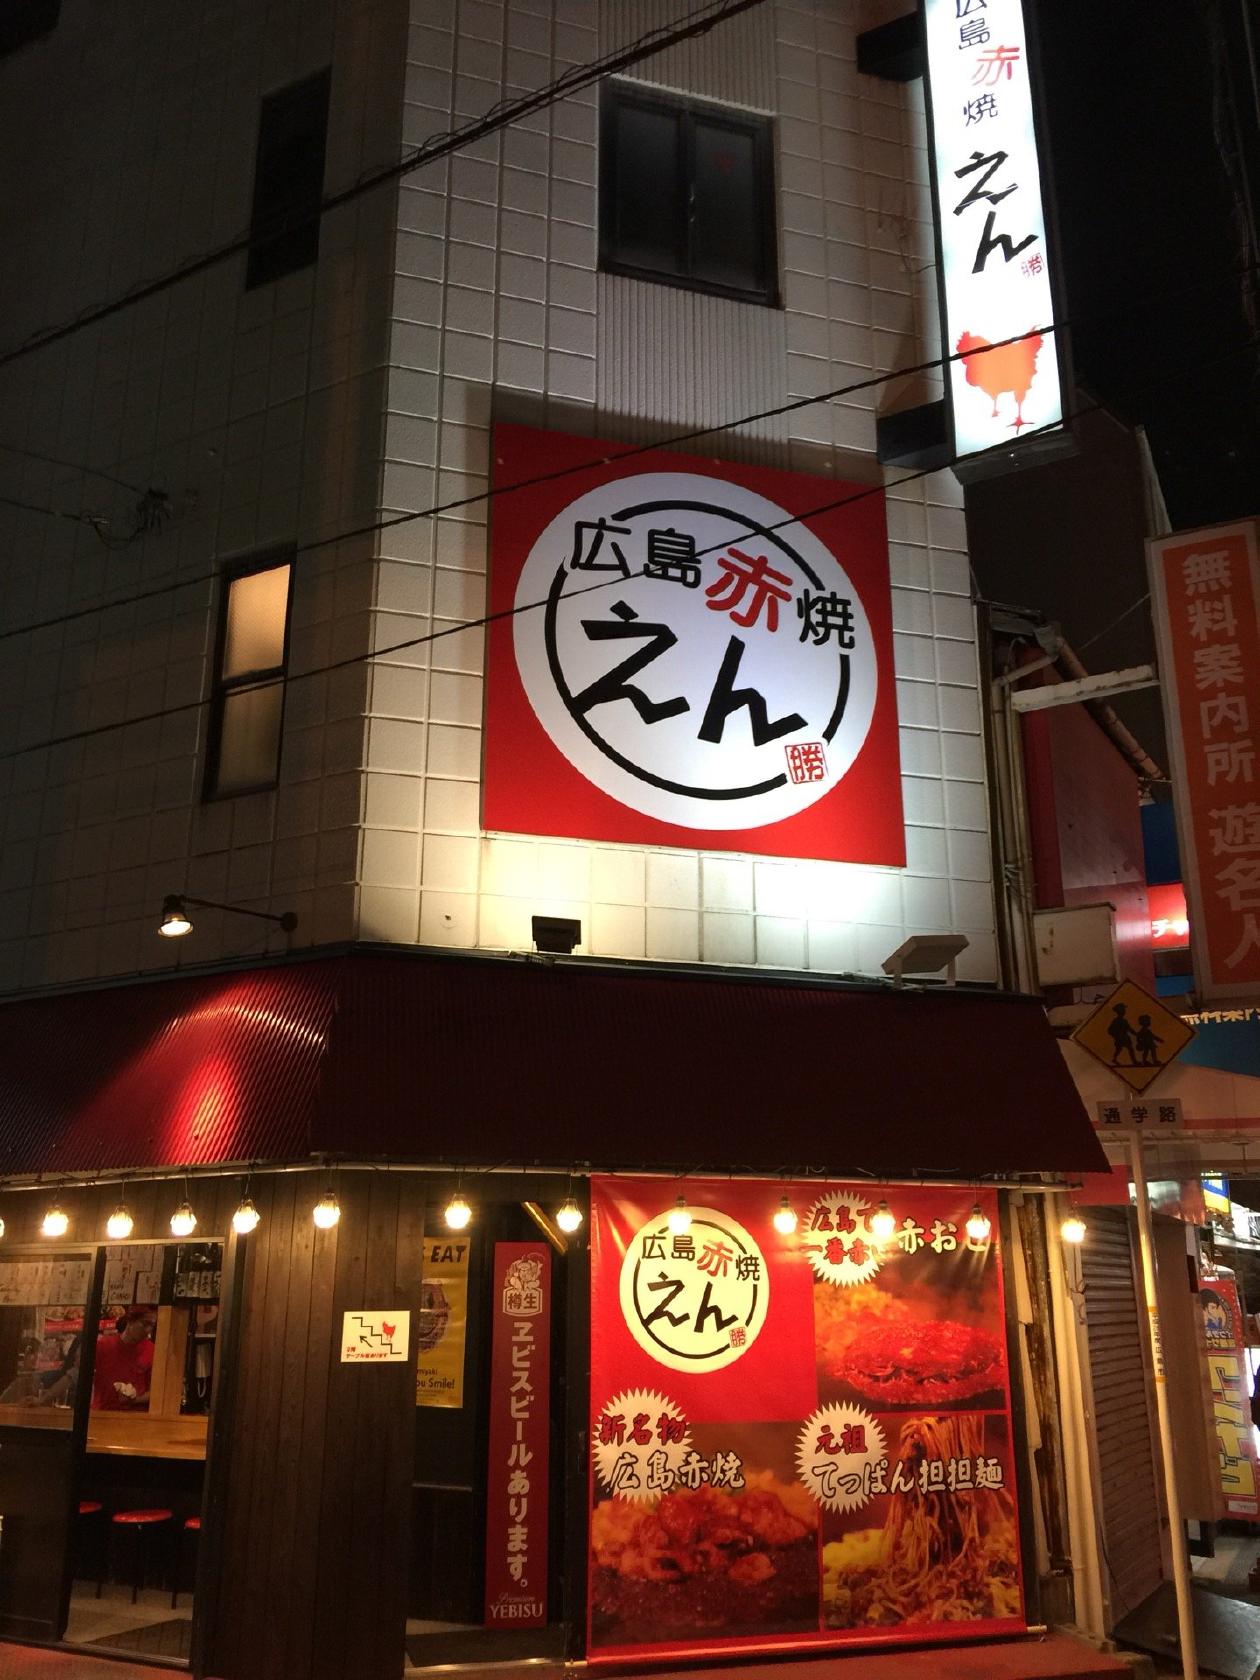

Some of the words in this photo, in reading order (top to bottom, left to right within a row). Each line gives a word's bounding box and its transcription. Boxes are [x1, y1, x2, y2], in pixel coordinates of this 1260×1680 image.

[953, 150, 1038, 274] えん
[570, 517, 856, 650] 広島赤焼
[570, 600, 809, 747] えん
[1182, 551, 1255, 786] 無料案内所
[786, 742, 828, 784] 勝
[1104, 1106, 1176, 1124] 通学路
[431, 1245, 467, 1263] EAT
[641, 1233, 761, 1282] 広島赤焼
[642, 1271, 739, 1333] えん
[428, 1376, 455, 1389] Smile!
[600, 1412, 687, 1447] 新名物
[815, 1423, 869, 1456] 元祖
[507, 1321, 536, 1588] ヱビスビールあります。
[609, 1449, 746, 1491] 広島赤焼
[489, 1602, 543, 1619] YEBISU
